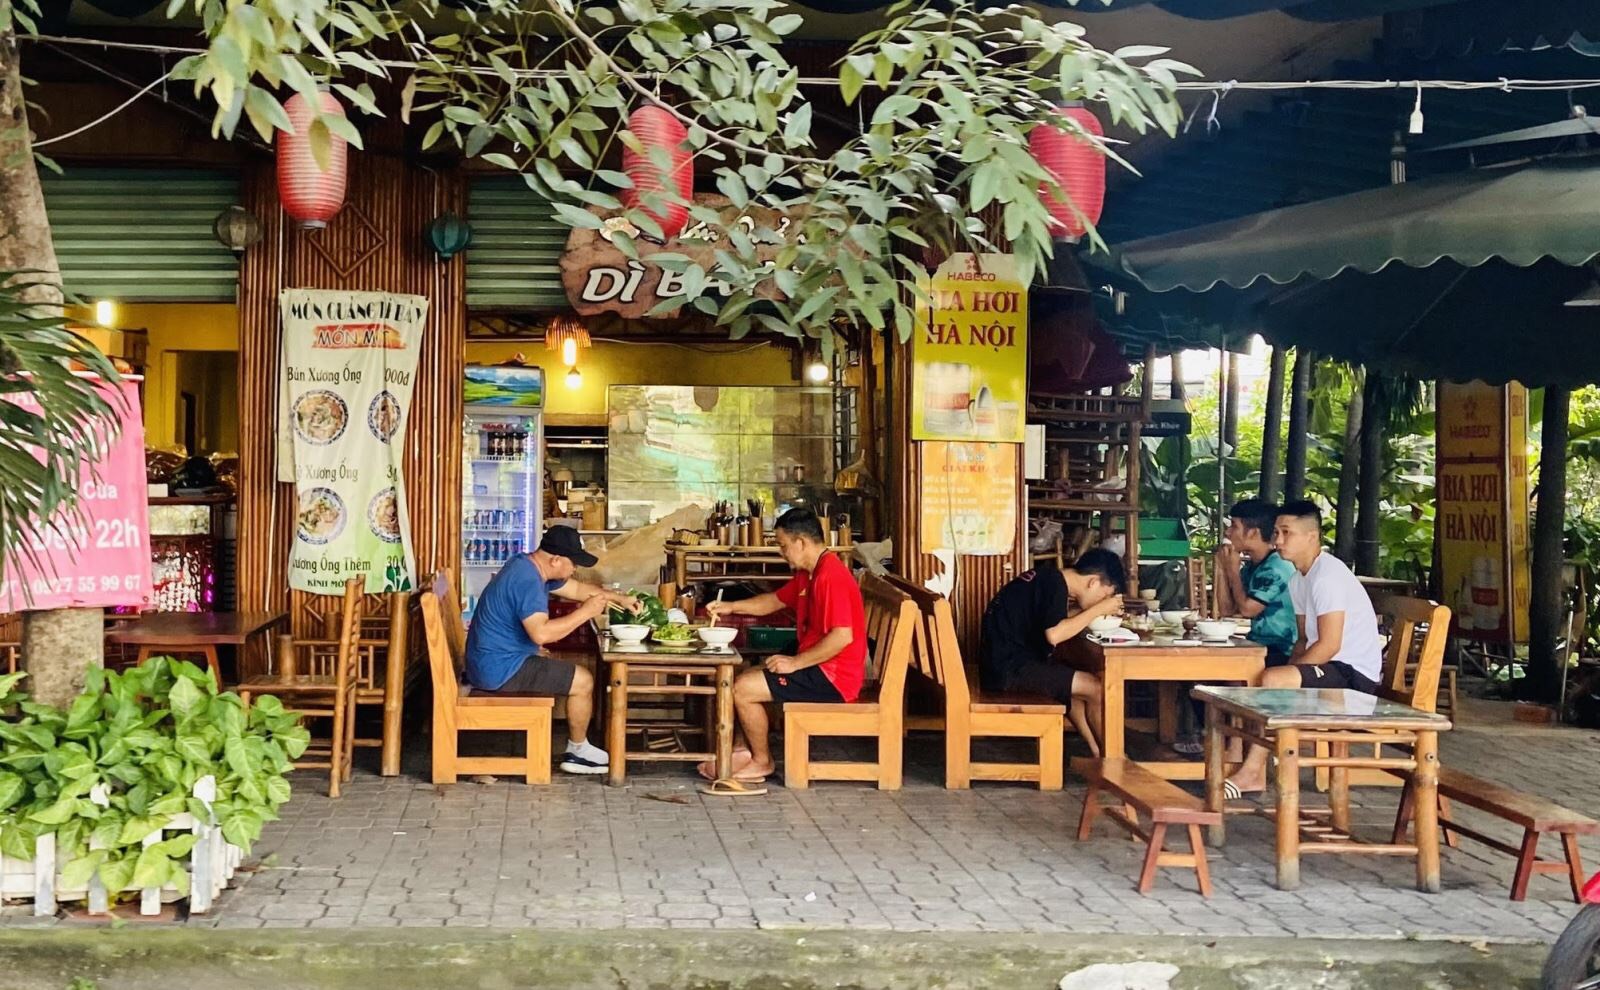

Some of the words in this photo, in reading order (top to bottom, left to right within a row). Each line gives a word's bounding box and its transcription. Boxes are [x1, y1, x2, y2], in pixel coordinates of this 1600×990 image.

[582, 260, 646, 302] DÌ
[947, 271, 996, 282] HABECO
[971, 290, 1021, 313] HƠI
[317, 325, 358, 345] MÓN
[926, 318, 962, 345] HÀ
[968, 320, 1017, 353] NỘI
[287, 366, 306, 382] Bún
[343, 360, 362, 384] Ống
[339, 458, 359, 482] Ống
[95, 517, 140, 548] 22h
[320, 549, 340, 575] Ống
[77, 576, 96, 593] 55
[100, 575, 119, 592] 99
[124, 574, 141, 591] 67
